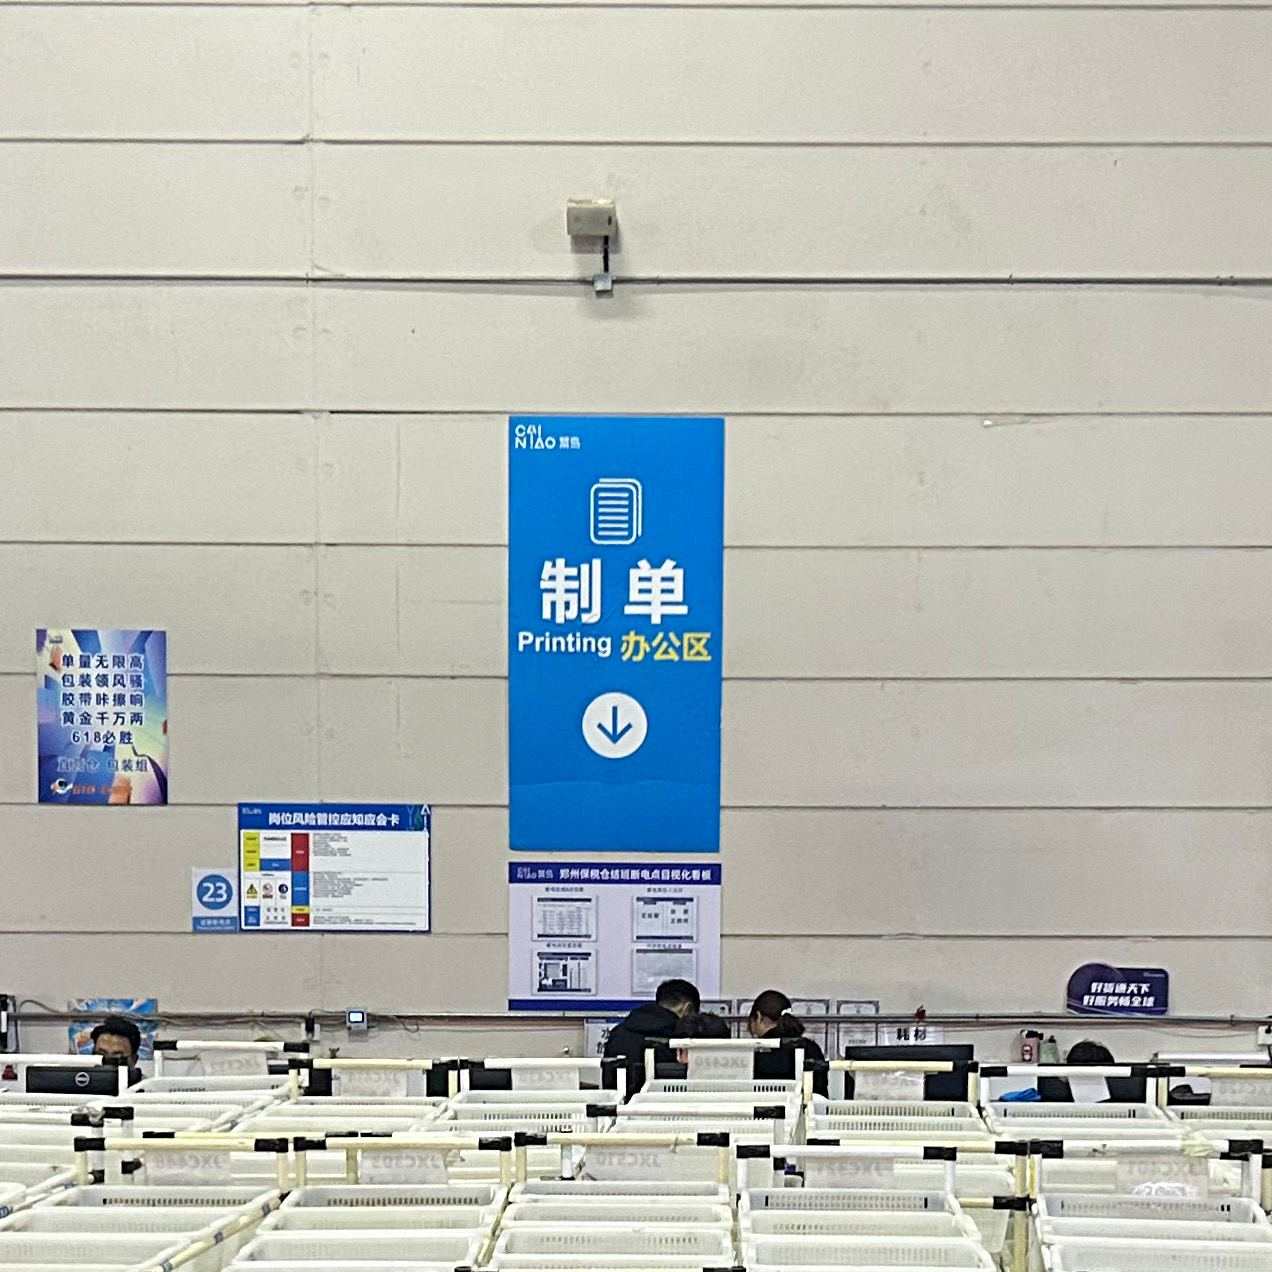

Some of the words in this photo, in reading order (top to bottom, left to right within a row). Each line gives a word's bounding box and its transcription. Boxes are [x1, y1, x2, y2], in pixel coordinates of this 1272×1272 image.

[540, 558, 688, 624] 制单
[518, 632, 612, 657] Printing
[620, 631, 712, 662] 办公区
[62, 654, 144, 669] 单量无限高
[62, 674, 144, 688] 包装领风骚
[62, 711, 144, 726] 黄金千万两
[202, 882, 228, 902] 23
